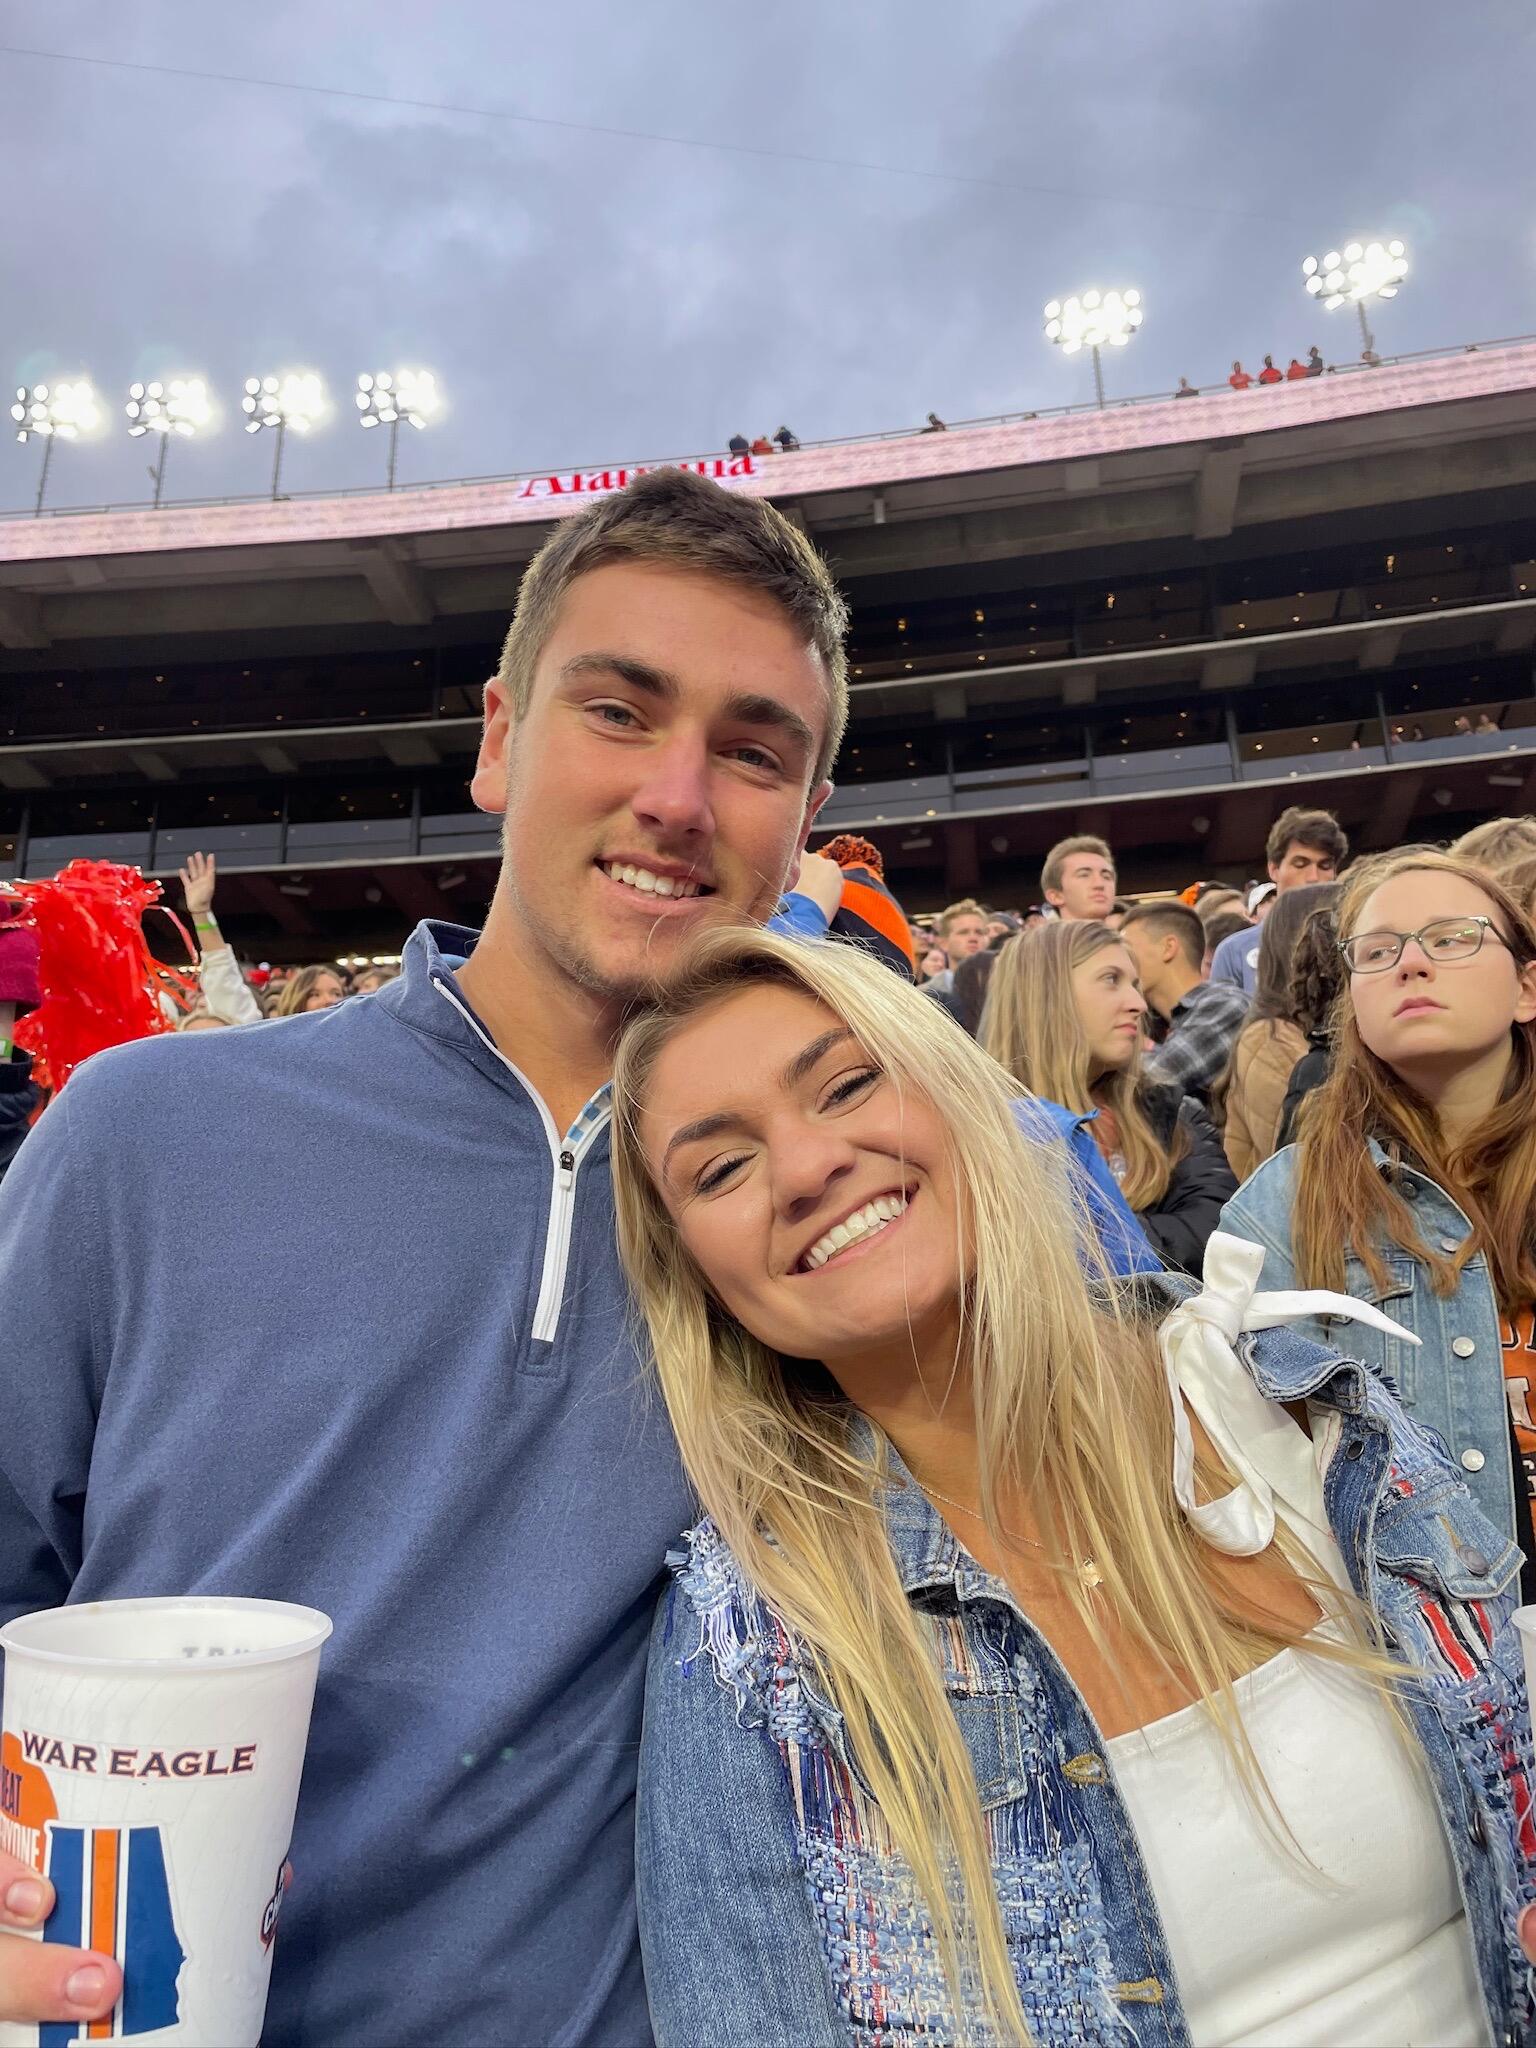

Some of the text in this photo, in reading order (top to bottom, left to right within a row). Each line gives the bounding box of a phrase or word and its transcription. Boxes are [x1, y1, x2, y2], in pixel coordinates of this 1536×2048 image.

[519, 455, 756, 497] Alama
[22, 1729, 257, 1778] WAR EAGLE
[1, 1765, 23, 1818] EAT
